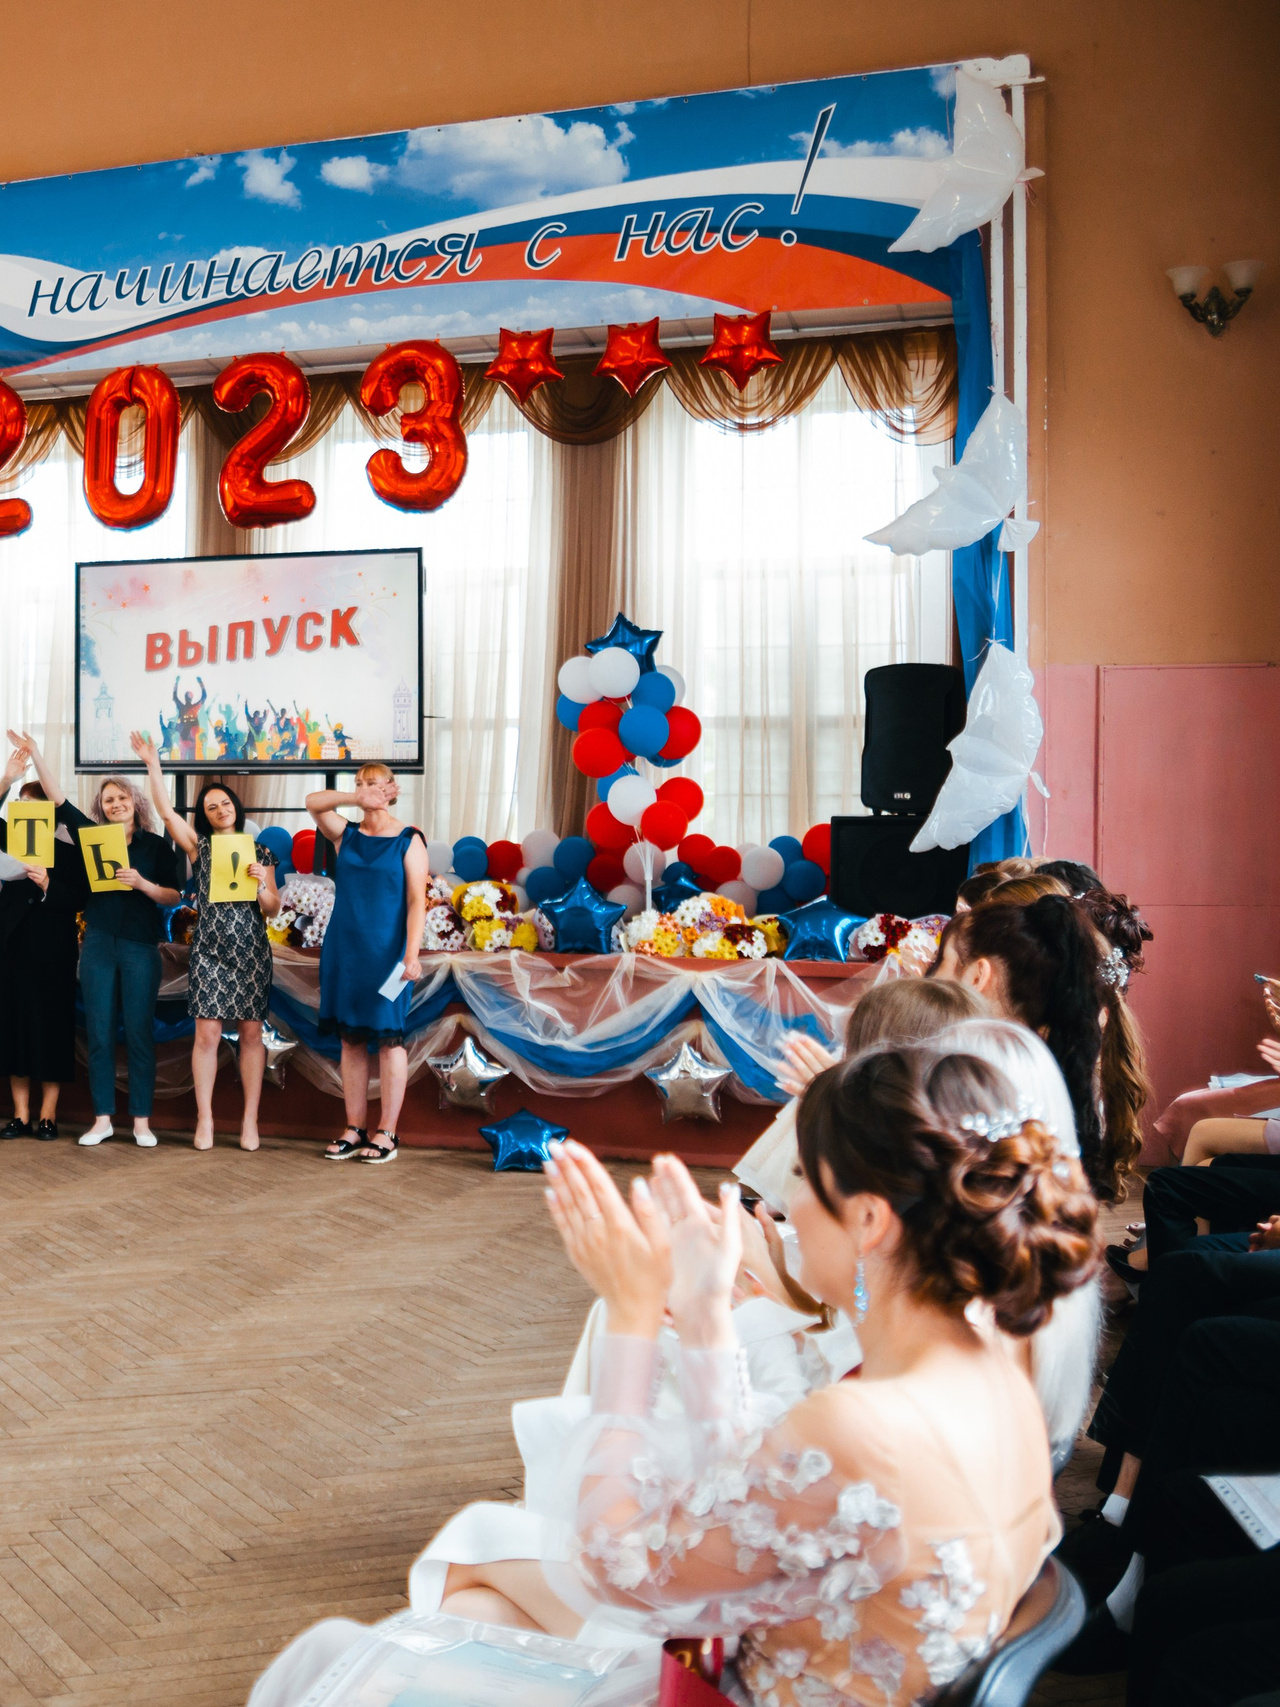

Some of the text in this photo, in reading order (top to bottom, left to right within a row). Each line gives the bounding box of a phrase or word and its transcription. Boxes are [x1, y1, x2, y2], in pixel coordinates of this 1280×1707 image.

[27, 229, 483, 318] начинается
[524, 222, 568, 270] с
[145, 606, 360, 673] ВЫПУСК
